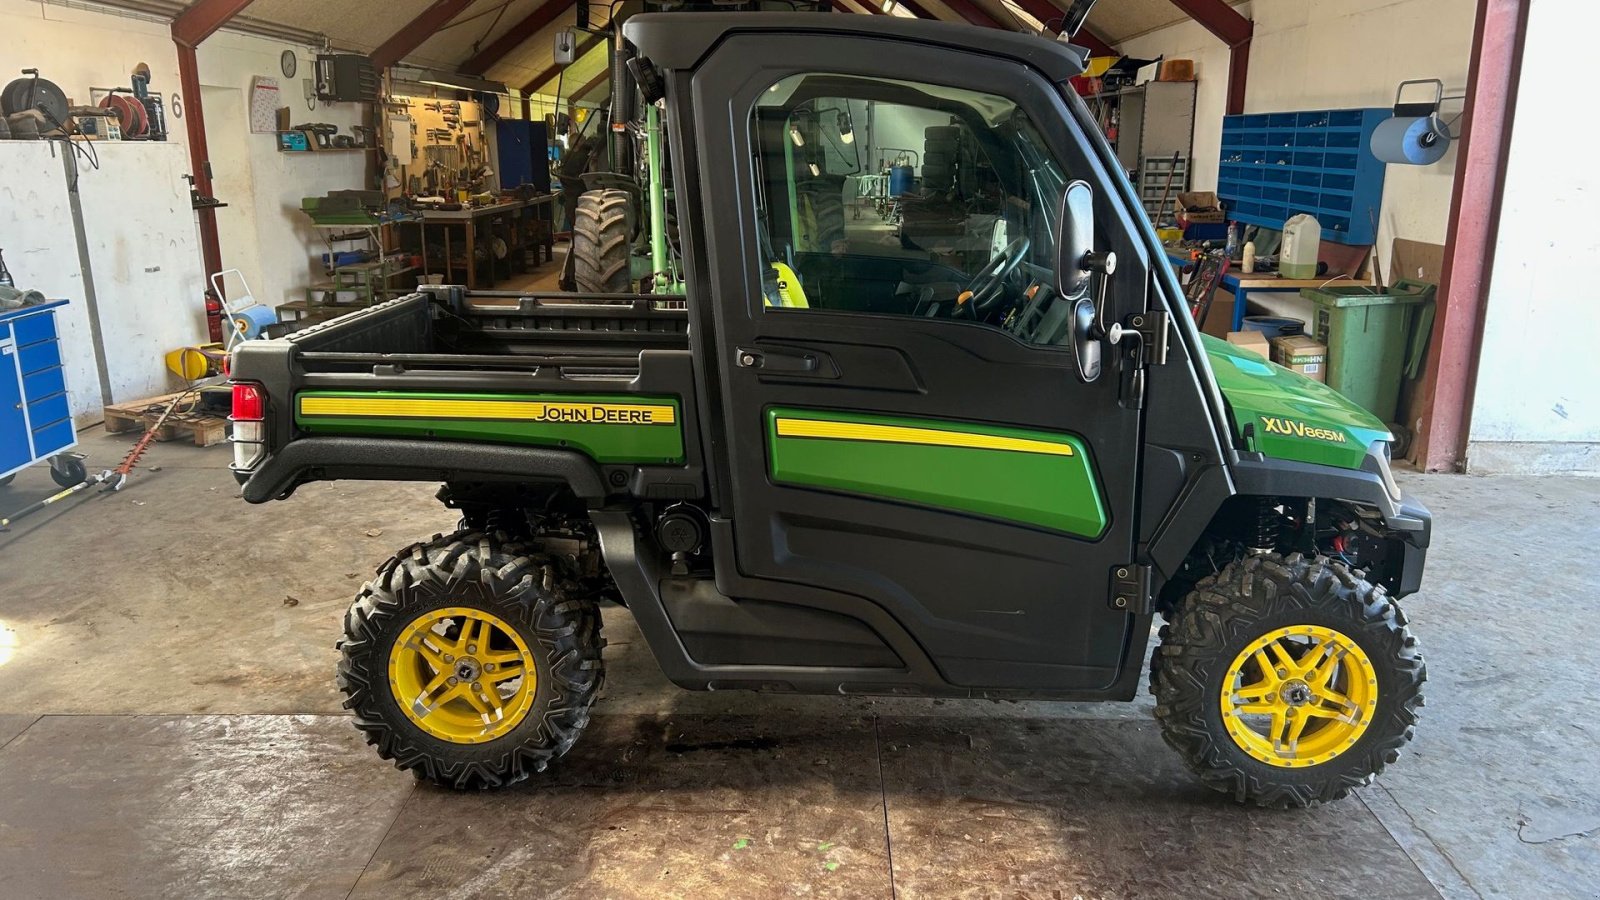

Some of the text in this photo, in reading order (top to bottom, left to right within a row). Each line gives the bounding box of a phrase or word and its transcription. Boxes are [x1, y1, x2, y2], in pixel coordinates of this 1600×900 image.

[171, 92, 183, 119] 6
[537, 405, 653, 422] JOHN DEERE
[1260, 416, 1346, 443] XUV865M
